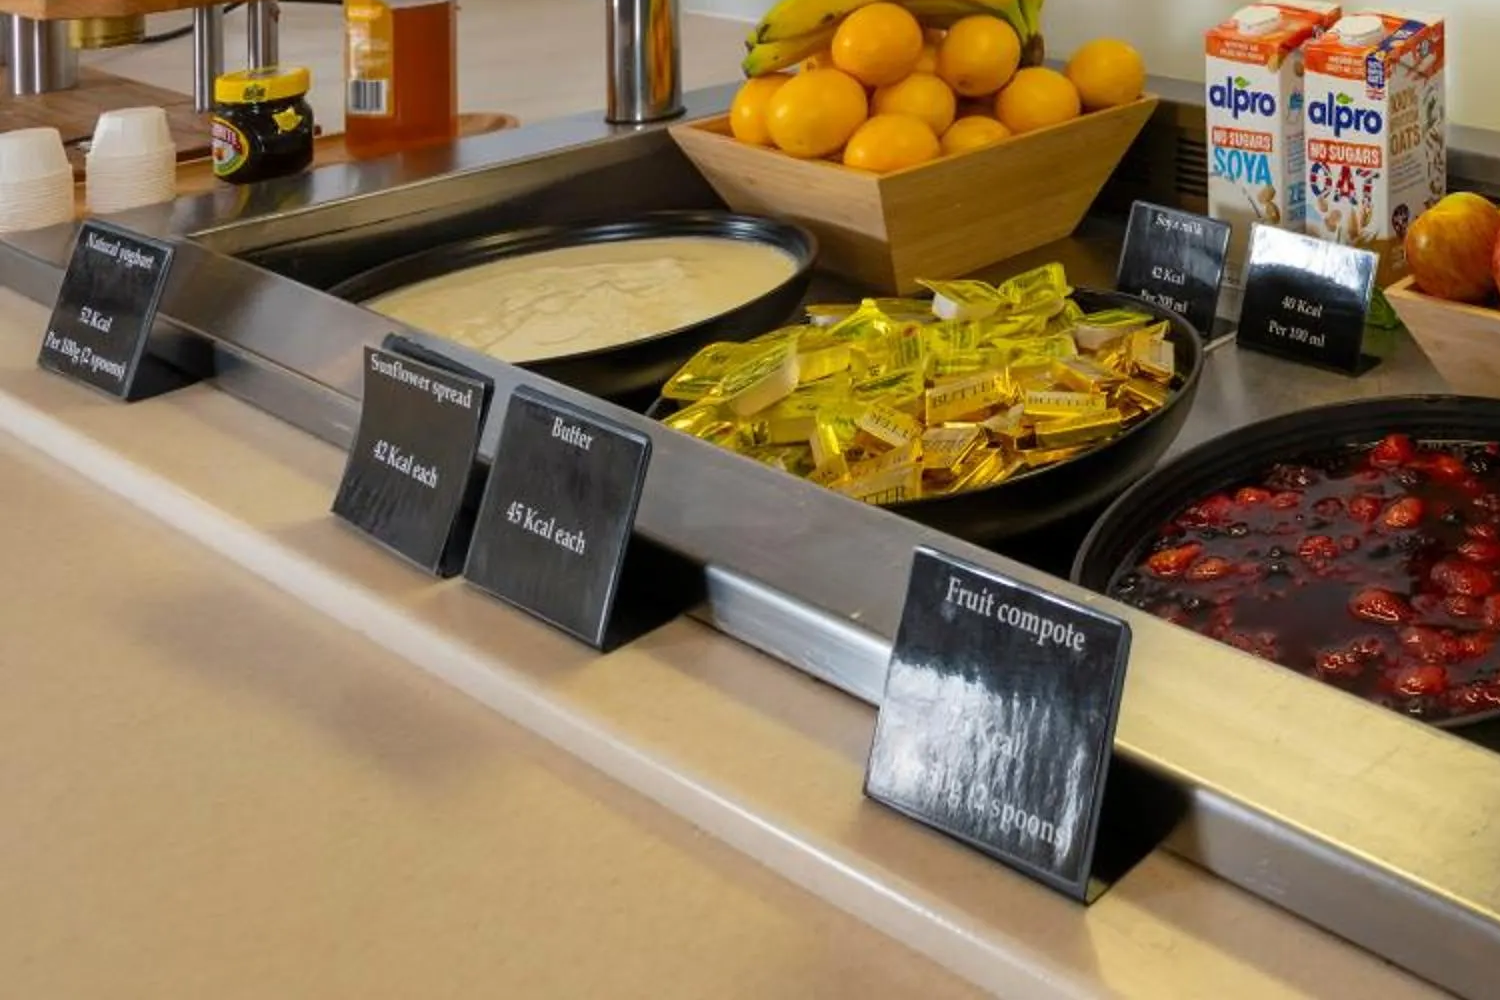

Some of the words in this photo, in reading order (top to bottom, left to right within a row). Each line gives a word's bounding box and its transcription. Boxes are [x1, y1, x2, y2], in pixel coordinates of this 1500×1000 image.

[1209, 76, 1277, 120] alpro
[1307, 91, 1383, 137] alpro
[1213, 147, 1273, 185] SOYA
[1328, 144, 1380, 166] SUGARS
[1310, 161, 1381, 207] OAT
[1297, 299, 1323, 318] Kcal
[1268, 319, 1287, 337] Per
[1309, 333, 1326, 348] ml
[370, 353, 430, 392] Sunflower
[432, 379, 473, 409] spread
[551, 415, 594, 451] Butter
[373, 439, 387, 462] 42
[386, 446, 415, 475] Kcal
[412, 461, 438, 489] each
[506, 500, 523, 524] 45
[522, 507, 555, 540] Kcal
[555, 525, 586, 556] each
[945, 575, 995, 624] Fruit
[996, 601, 1087, 652] compote
